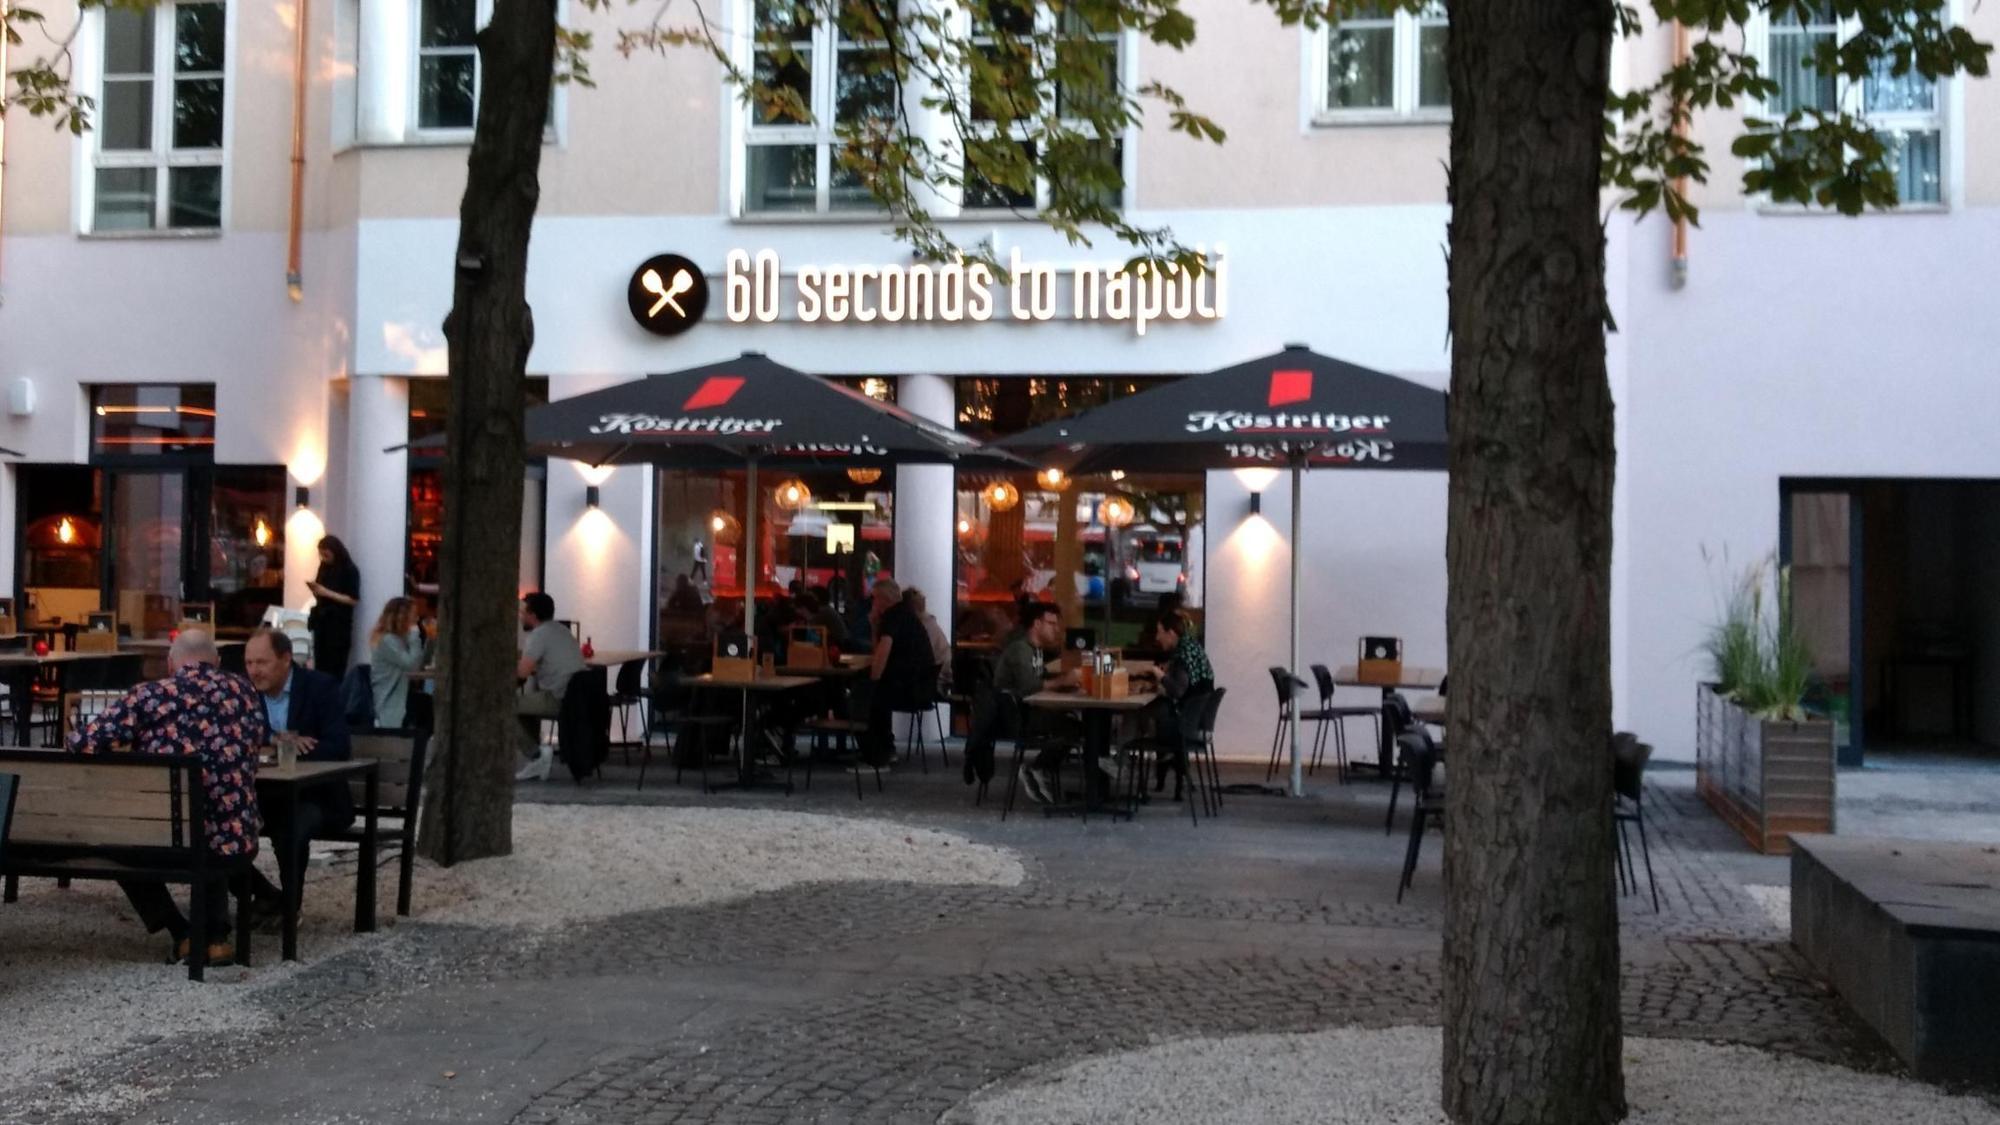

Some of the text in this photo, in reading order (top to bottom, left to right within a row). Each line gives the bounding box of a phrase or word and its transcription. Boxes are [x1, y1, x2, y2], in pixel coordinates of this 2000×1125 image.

[726, 242, 1226, 336] 60 seconds to napoli
